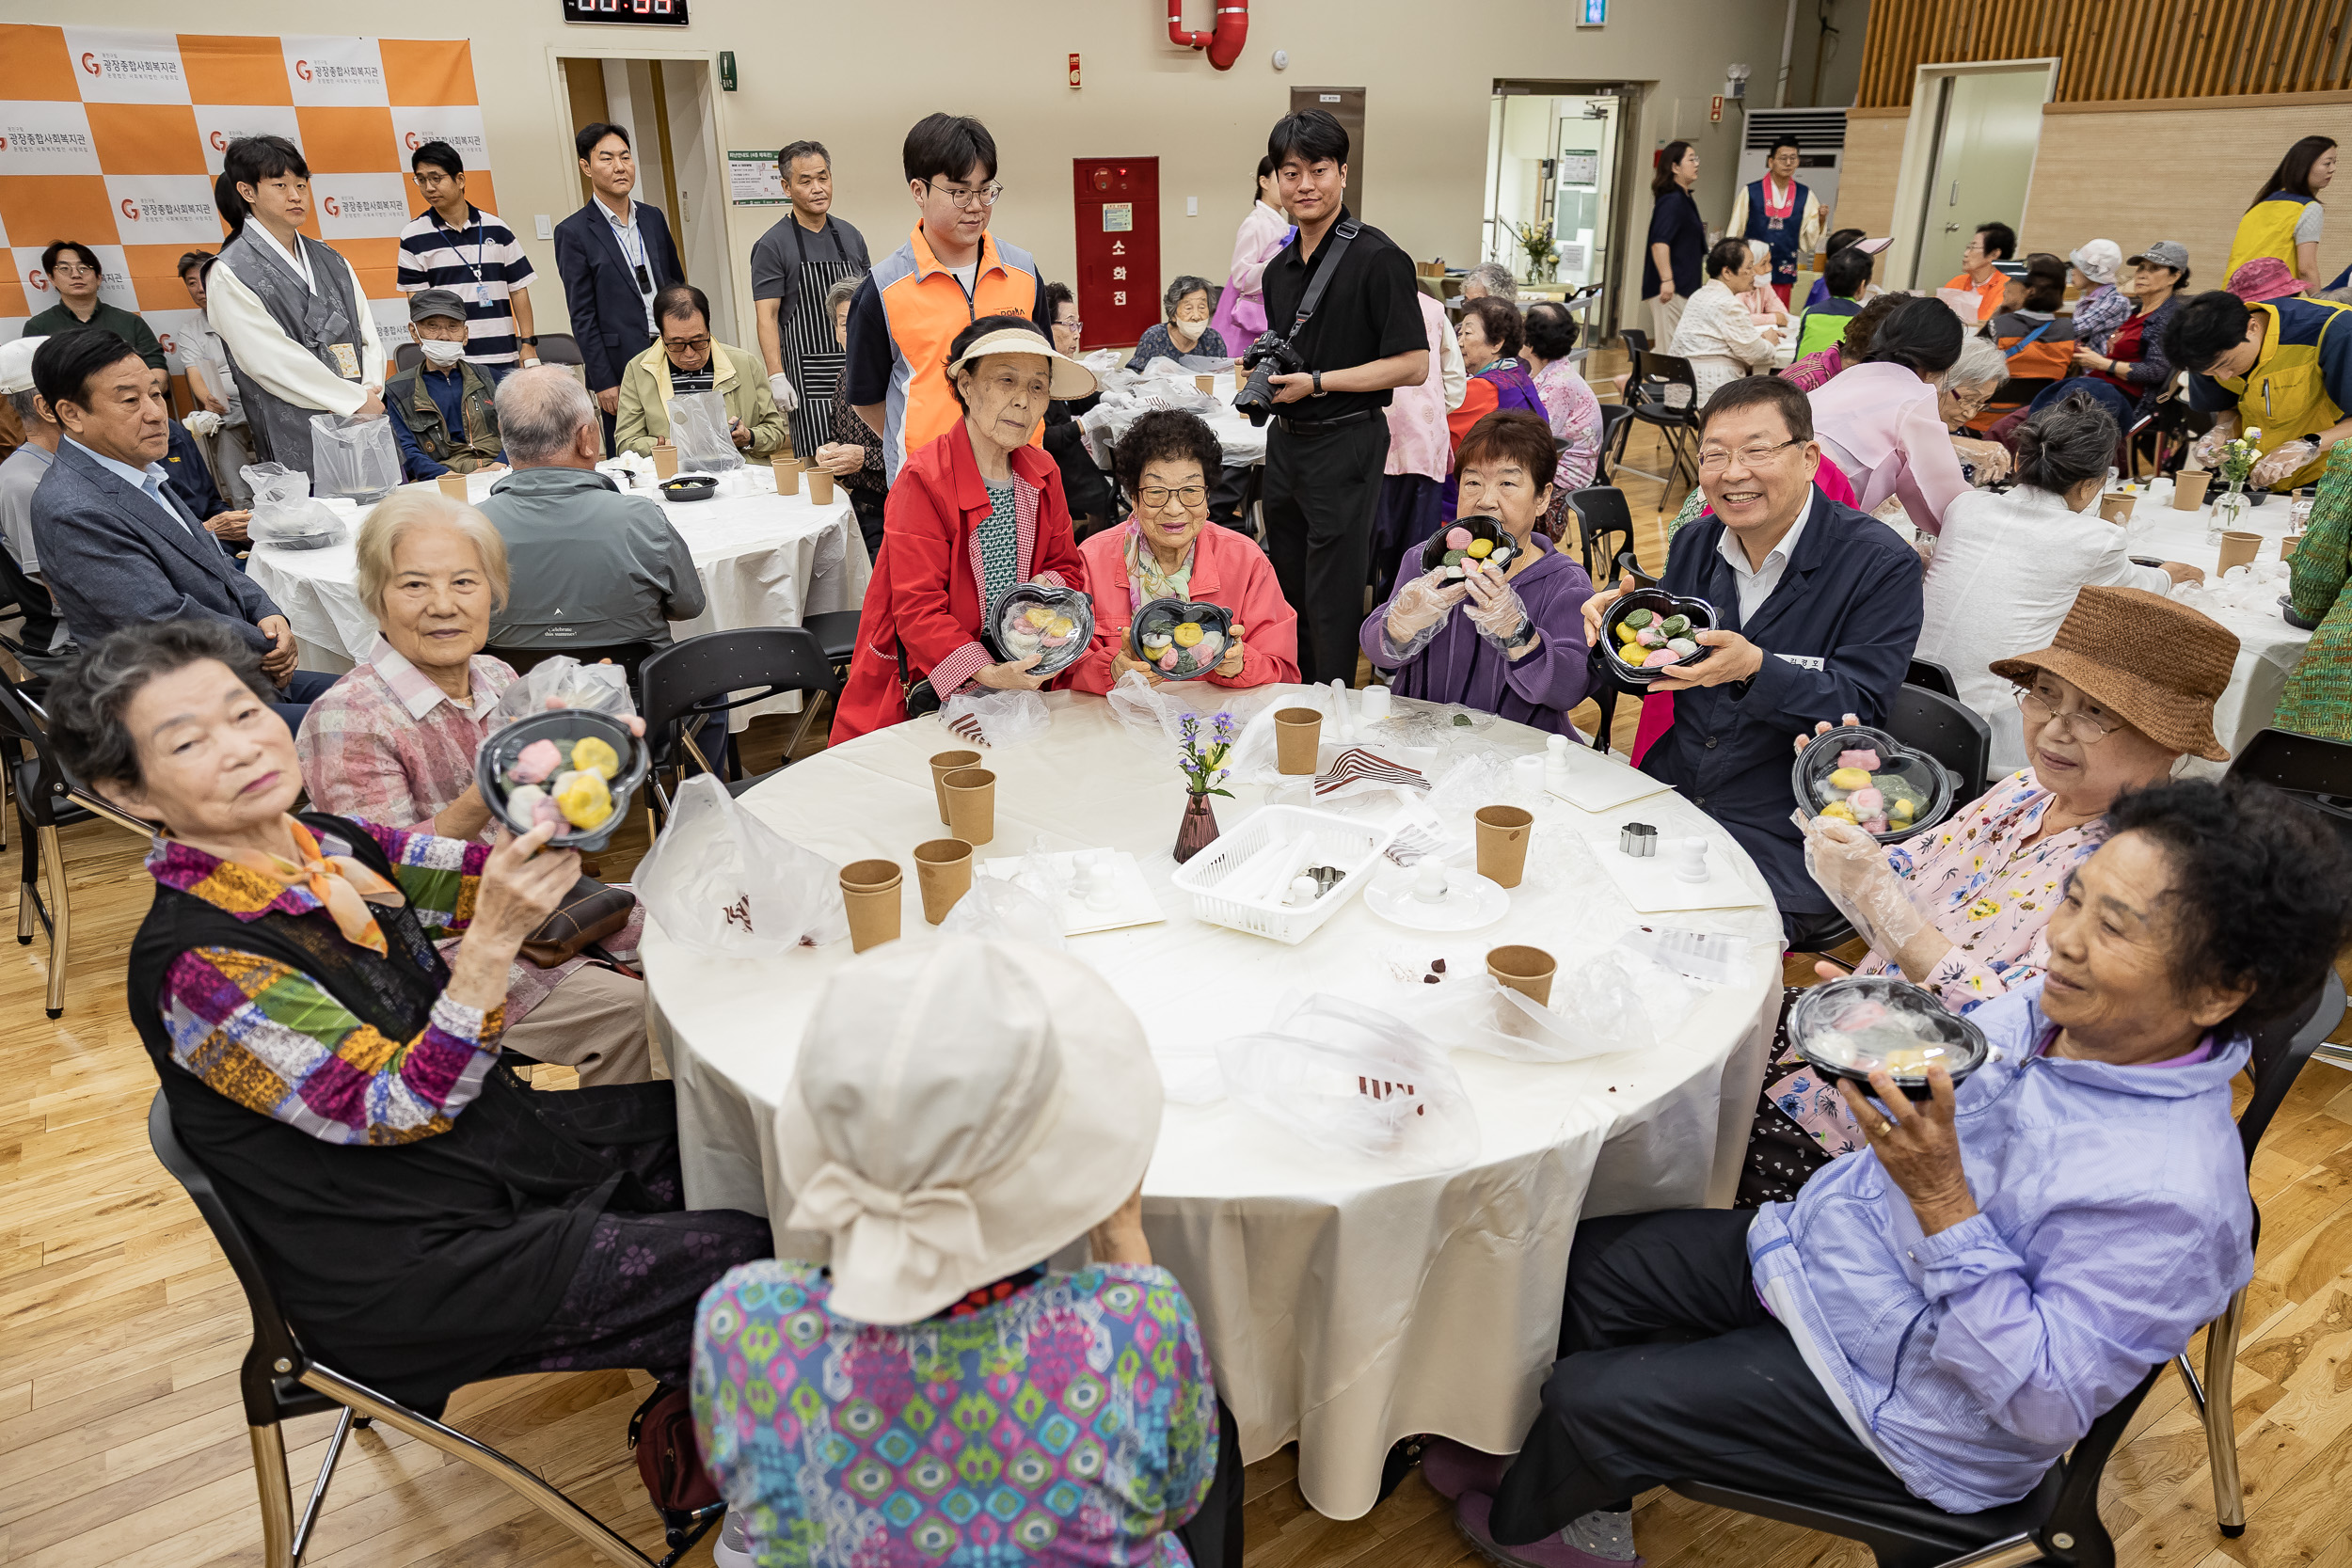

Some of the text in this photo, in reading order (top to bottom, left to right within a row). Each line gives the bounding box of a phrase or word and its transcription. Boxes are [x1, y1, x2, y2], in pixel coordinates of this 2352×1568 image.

[103, 59, 177, 73] 광장종합사회복지관
[314, 66, 378, 78] 광장종합사회복지관
[8, 133, 86, 145] 광장종합사회복지관
[141, 204, 211, 215] 광장종합사회복지관
[342, 200, 403, 212] 광장종합사회복지관
[1112, 240, 1127, 306] 소화전
